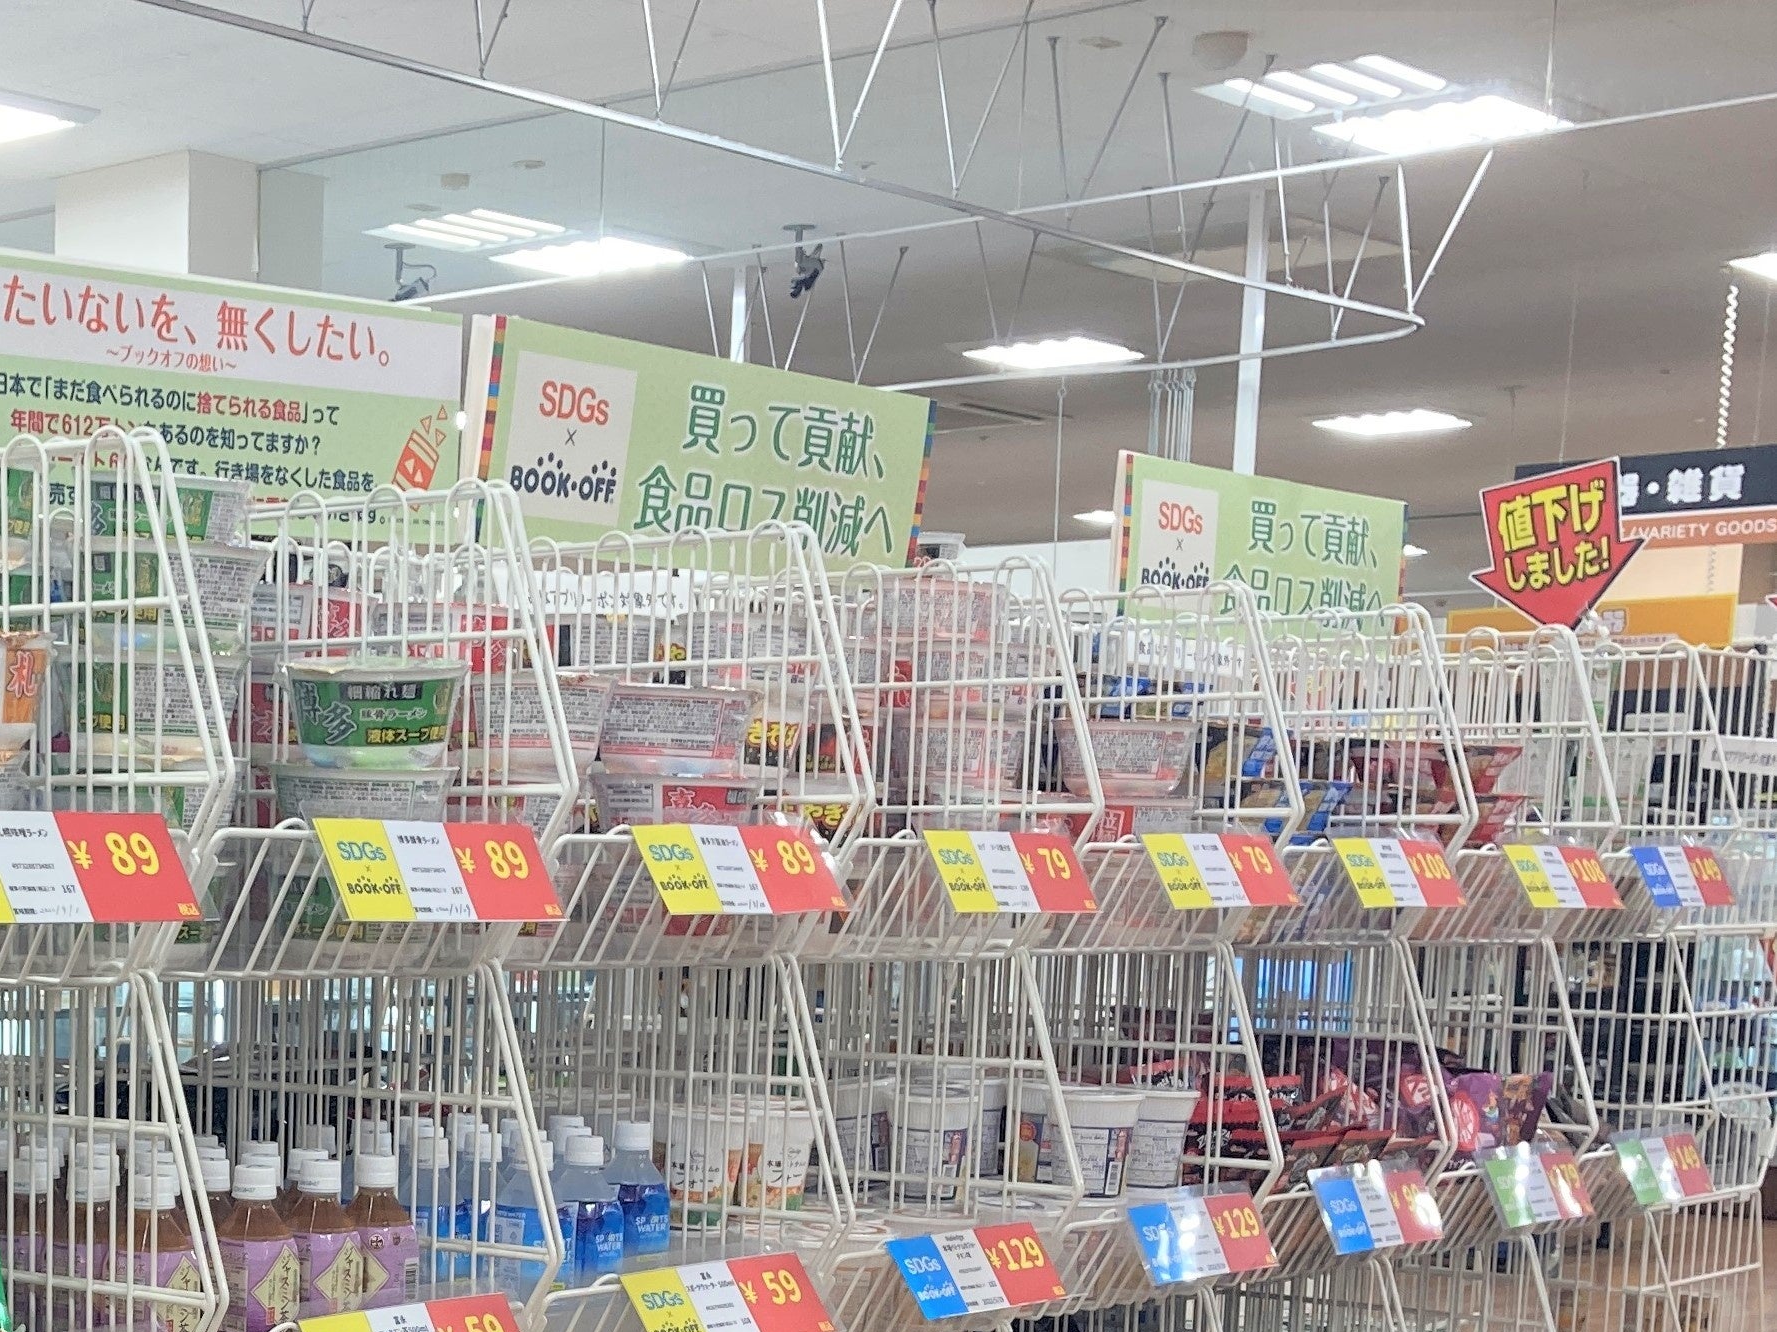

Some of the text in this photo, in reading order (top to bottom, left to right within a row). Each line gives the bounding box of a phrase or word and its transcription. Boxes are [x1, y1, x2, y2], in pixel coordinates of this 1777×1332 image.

[539, 380, 610, 426] SDGs
[682, 384, 885, 480] 買って貢献、
[1157, 501, 1204, 535] SDGs
[1249, 499, 1378, 570] 買って貢献、
[1497, 479, 1606, 553] 値下げ
[336, 840, 387, 864] SDGs
[647, 842, 695, 864] SDGs
[640, 1288, 685, 1312] SDGs
